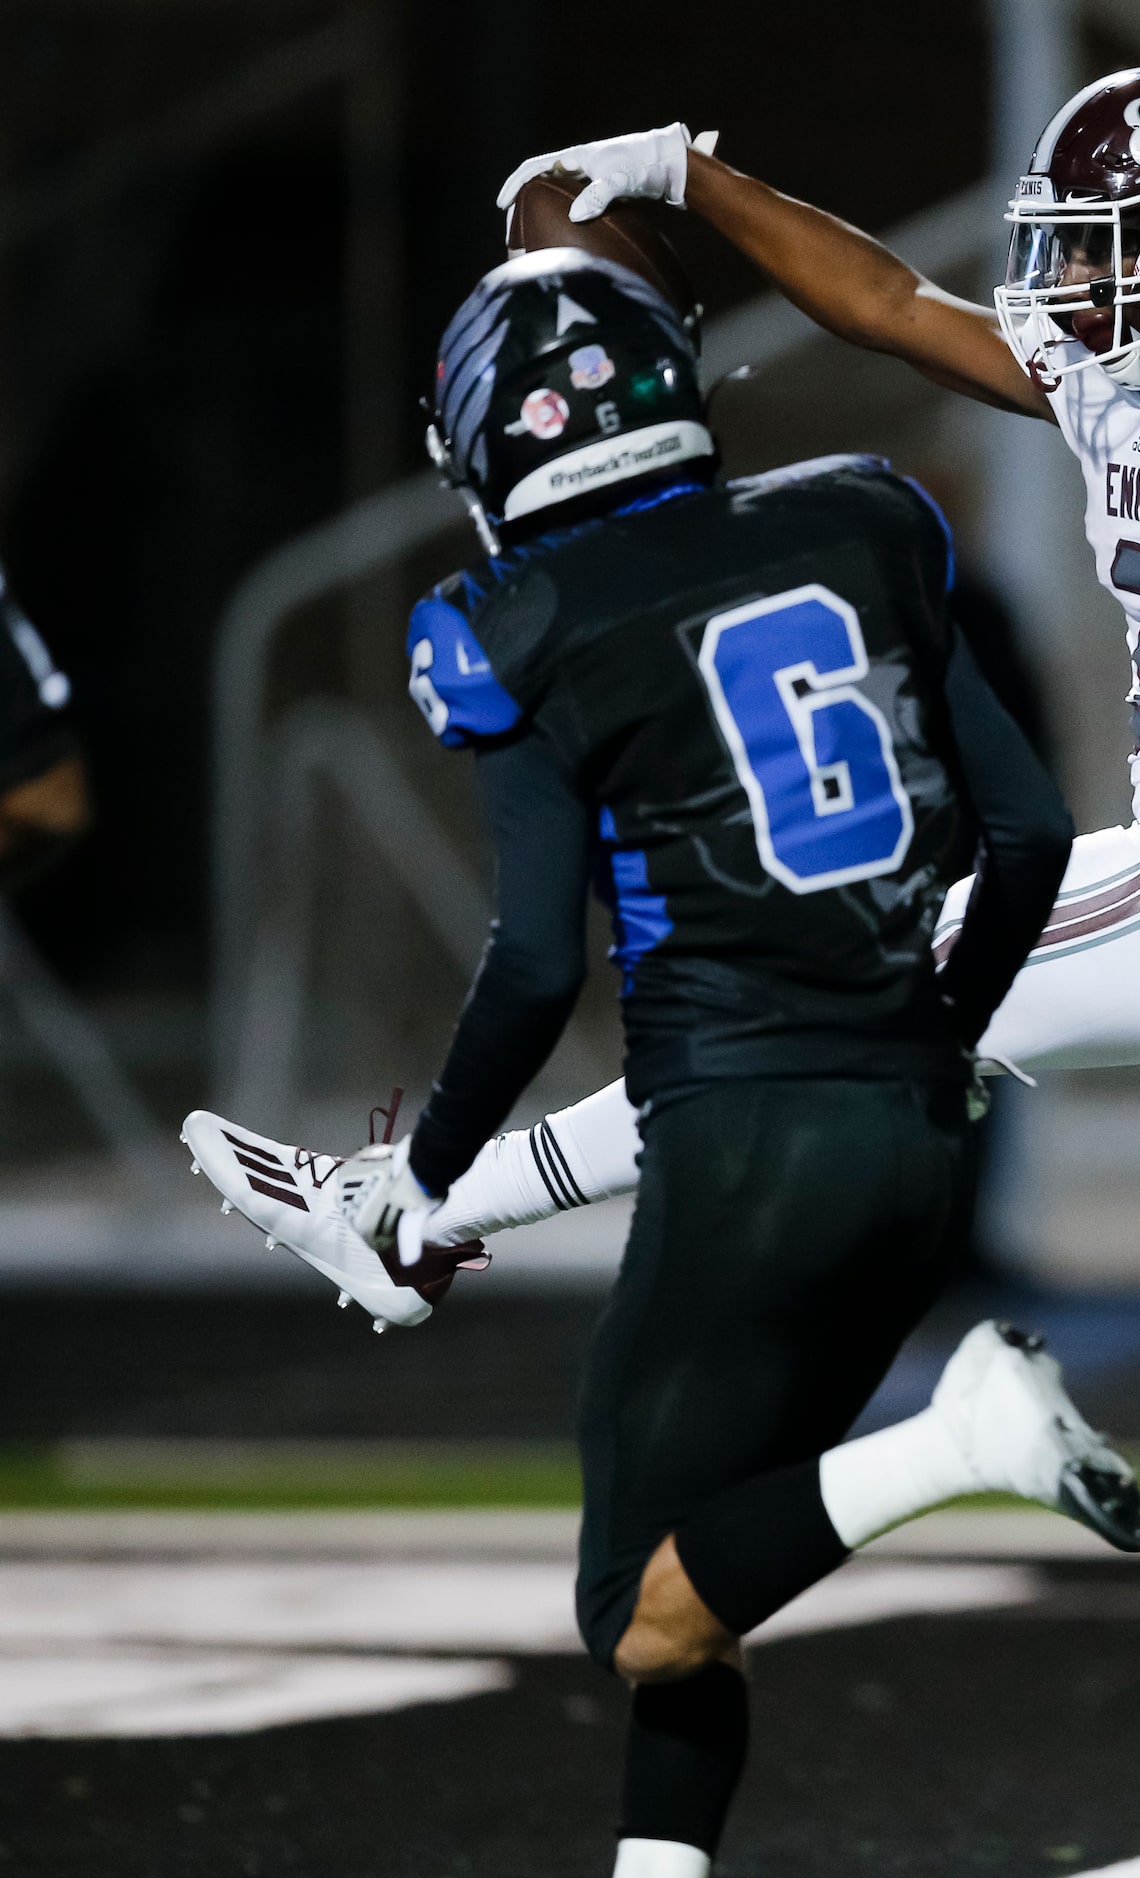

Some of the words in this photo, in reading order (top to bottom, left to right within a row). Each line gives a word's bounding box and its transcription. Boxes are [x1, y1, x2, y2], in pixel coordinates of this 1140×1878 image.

[595, 401, 621, 434] 6
[408, 637, 450, 738] 6
[697, 583, 915, 895] 6
